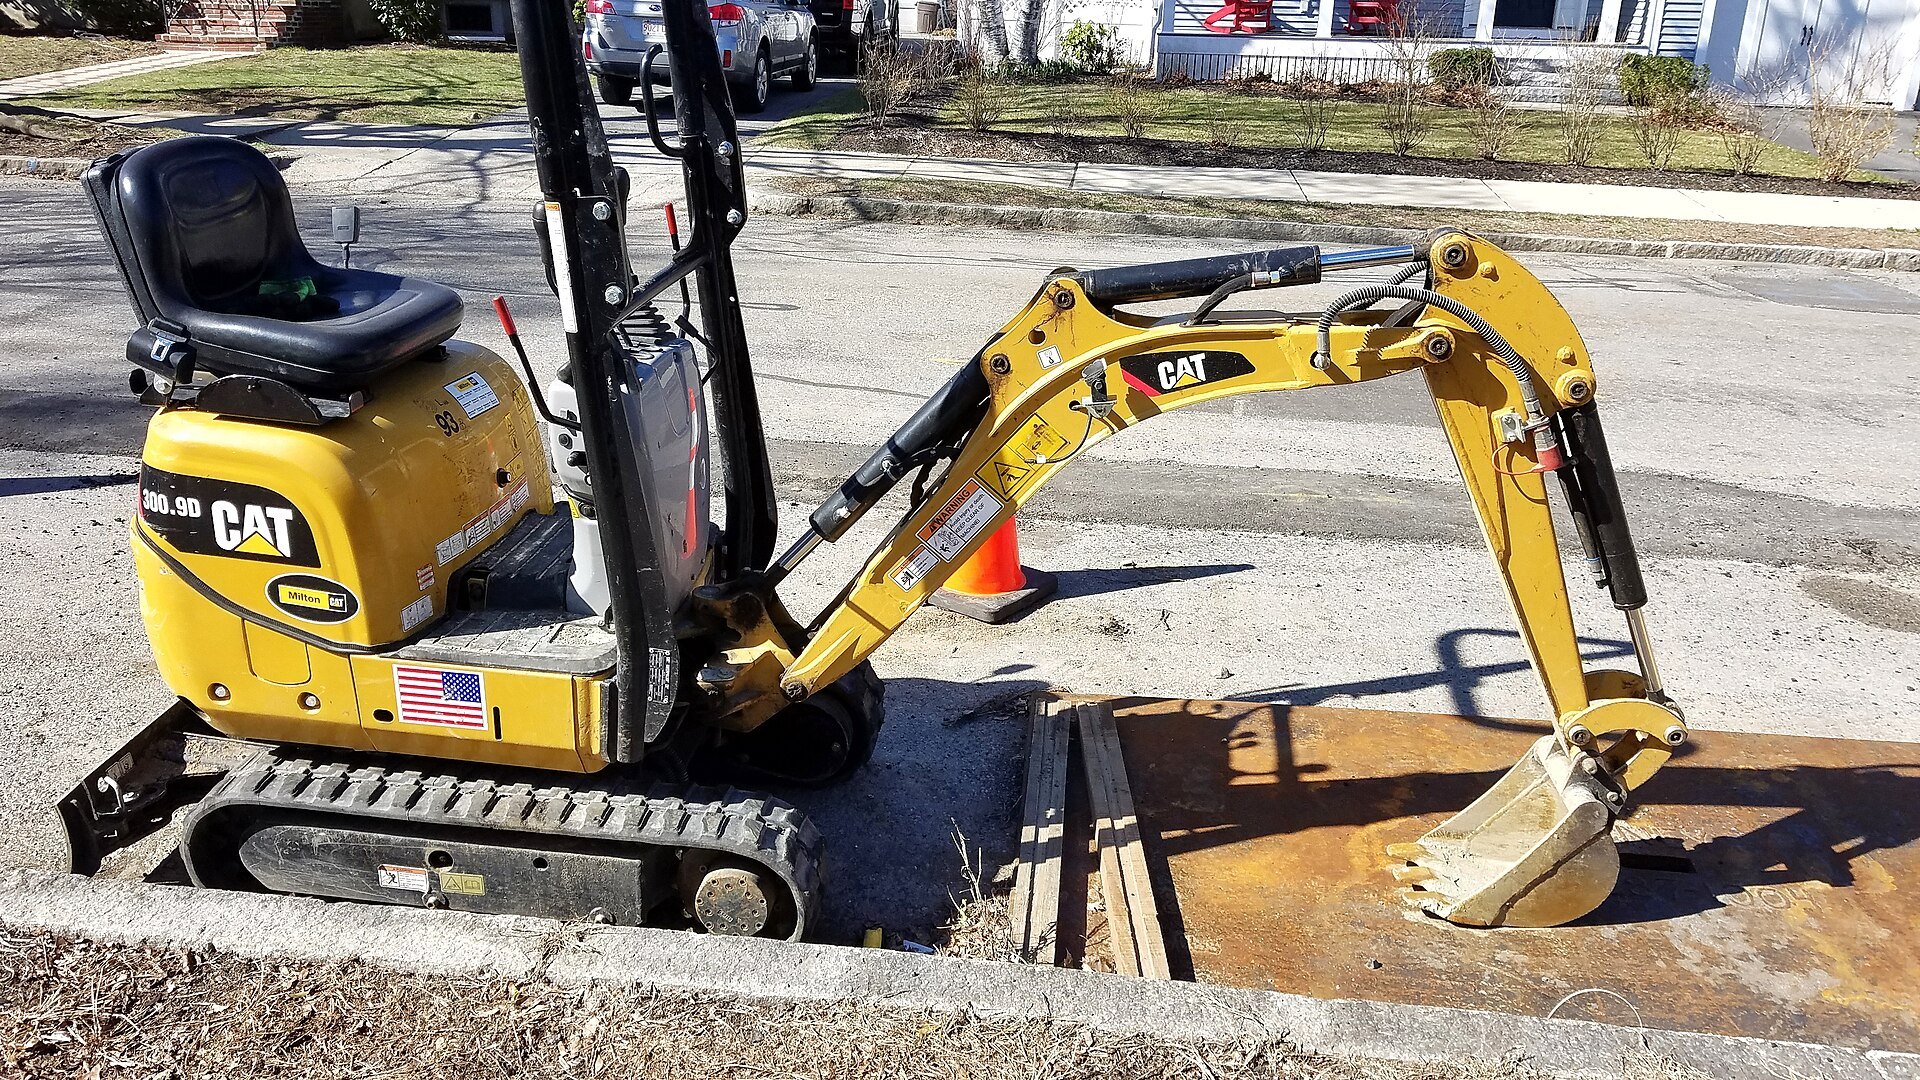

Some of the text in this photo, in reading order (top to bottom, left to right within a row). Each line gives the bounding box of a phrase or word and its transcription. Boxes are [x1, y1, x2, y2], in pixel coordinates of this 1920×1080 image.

[1157, 353, 1206, 390] CAT
[435, 410, 459, 437] 93
[142, 488, 201, 518] 300.9D
[935, 489, 971, 525] WARNING
[955, 502, 985, 533] KEEP CLEAR OF
[211, 500, 293, 557] CAT
[288, 591, 344, 607] Milton CAT
